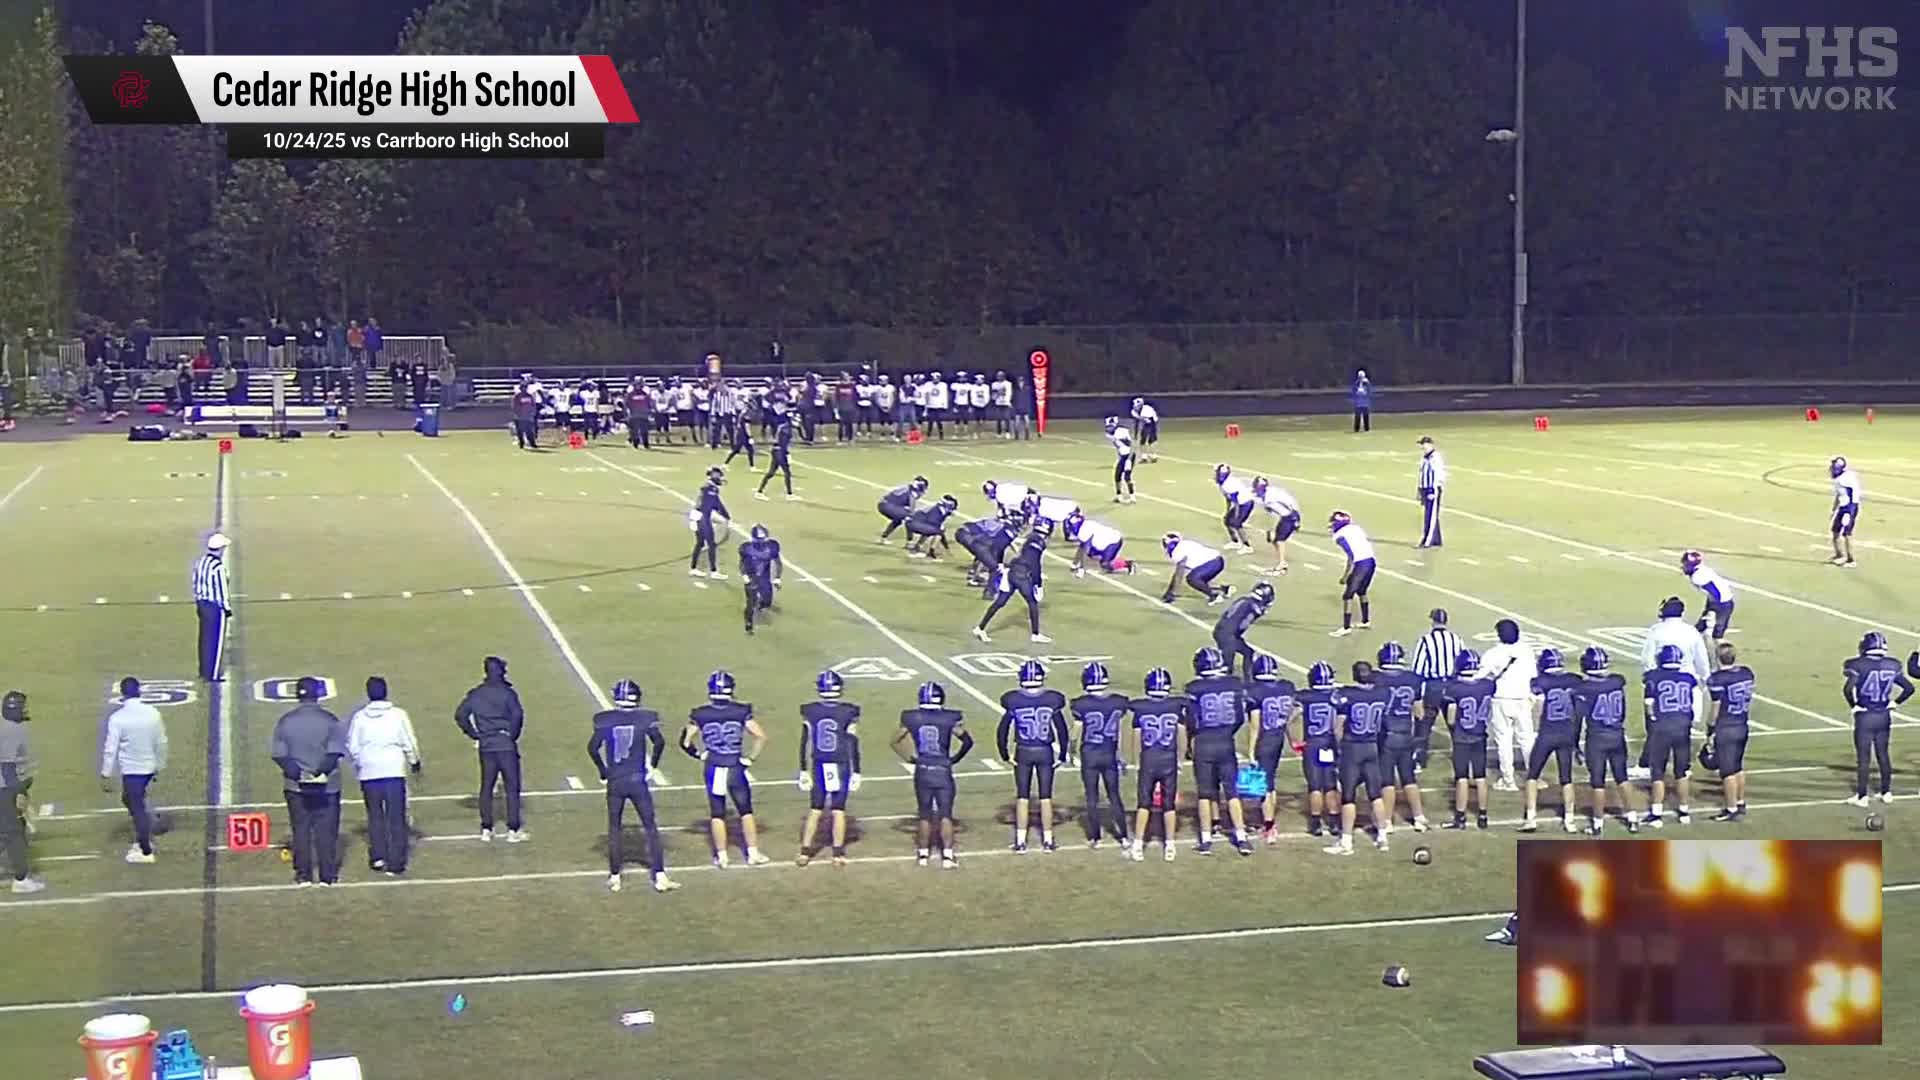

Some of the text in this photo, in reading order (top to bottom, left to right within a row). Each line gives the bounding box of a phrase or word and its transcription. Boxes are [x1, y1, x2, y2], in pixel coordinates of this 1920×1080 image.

[1658, 680, 1691, 713] 20
[1861, 670, 1896, 702] 47
[1015, 706, 1053, 740] 58
[1459, 696, 1492, 729] 34
[1592, 690, 1623, 725] 40
[703, 722, 741, 755] 22
[817, 719, 837, 753] 6
[1085, 710, 1122, 744] 24
[1139, 713, 1178, 746] 66
[232, 818, 263, 846] 50
[269, 1023, 289, 1047] G
[106, 1052, 128, 1074] G
